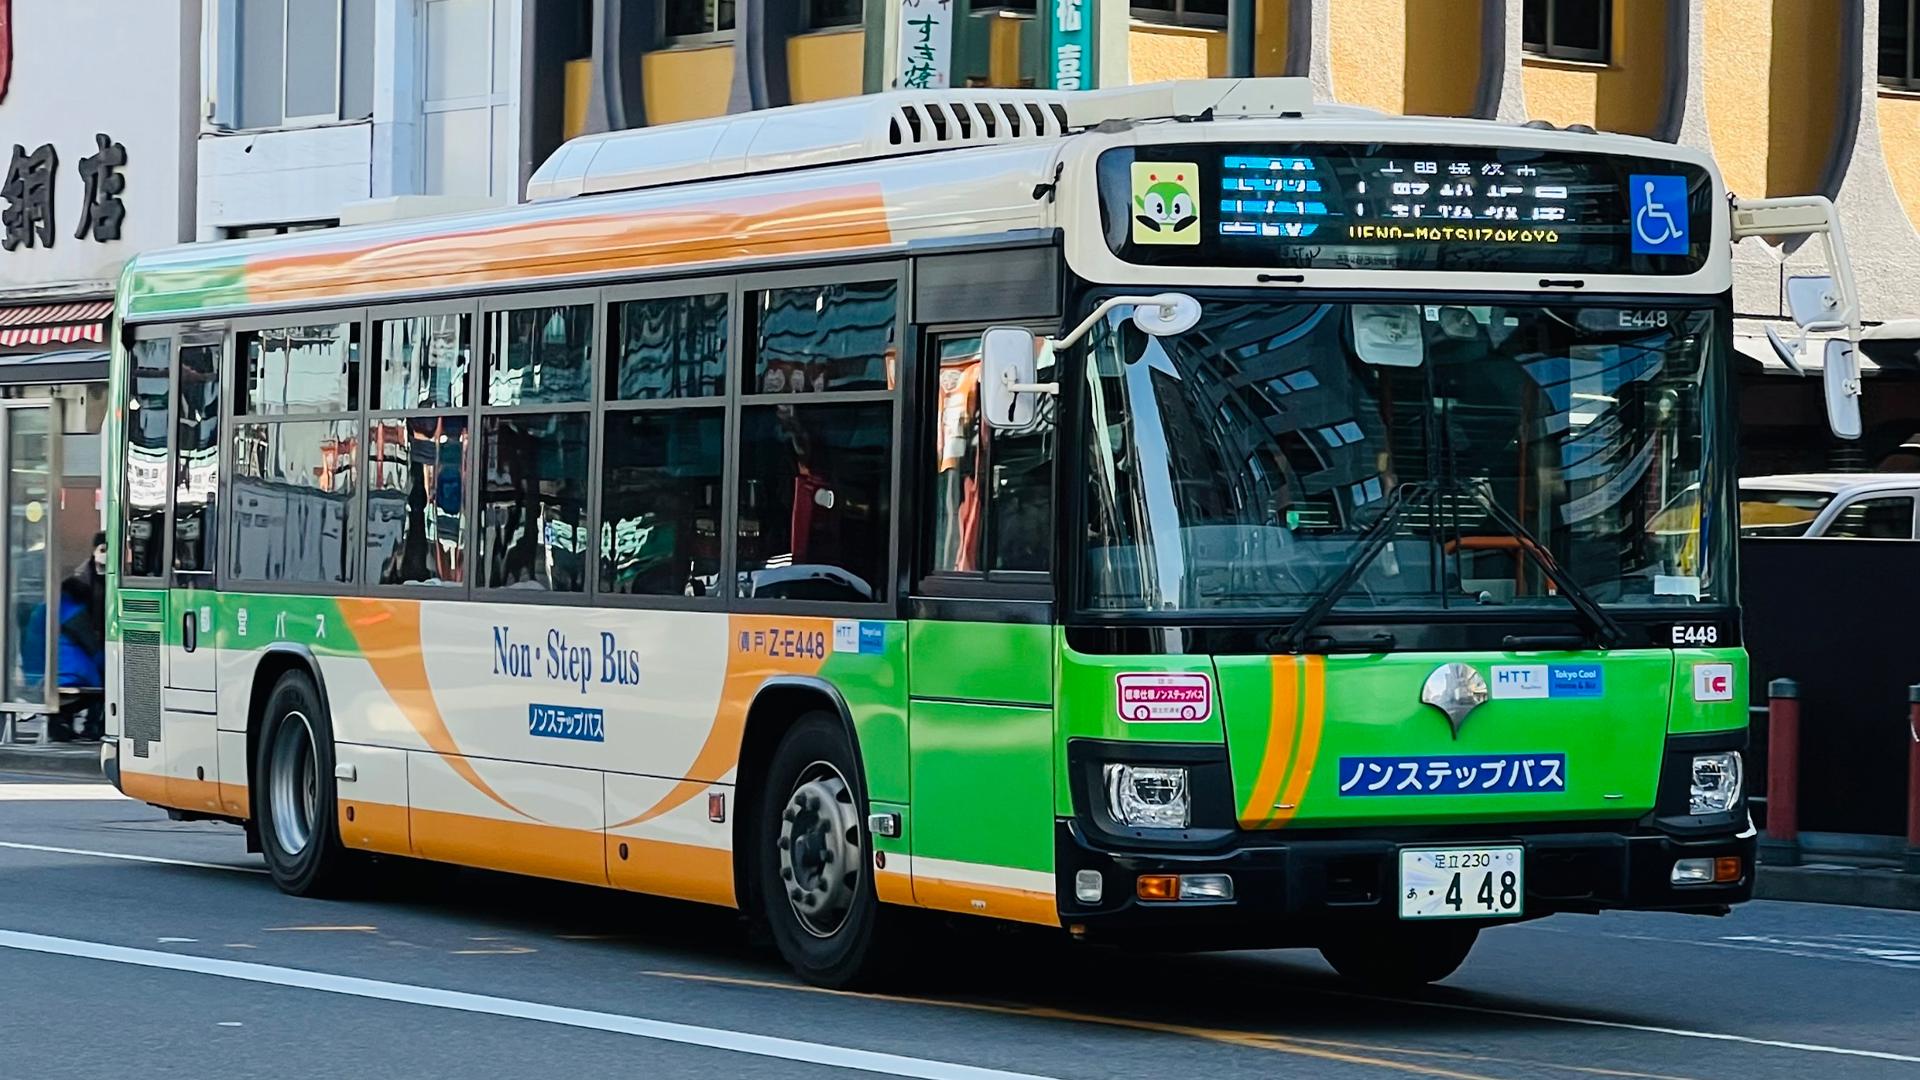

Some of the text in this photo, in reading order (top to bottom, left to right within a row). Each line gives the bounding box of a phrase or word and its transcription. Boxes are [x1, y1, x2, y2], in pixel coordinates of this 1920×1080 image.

[1619, 310, 1668, 327] E448
[768, 628, 825, 660] Z-E448
[1672, 626, 1717, 643] E448
[600, 631, 640, 685] Bus
[1554, 669, 1578, 680] Tokyo
[530, 707, 604, 738] ノンステップバス
[1341, 759, 1564, 792] ノンステップバス
[1407, 887, 1417, 900] あ
